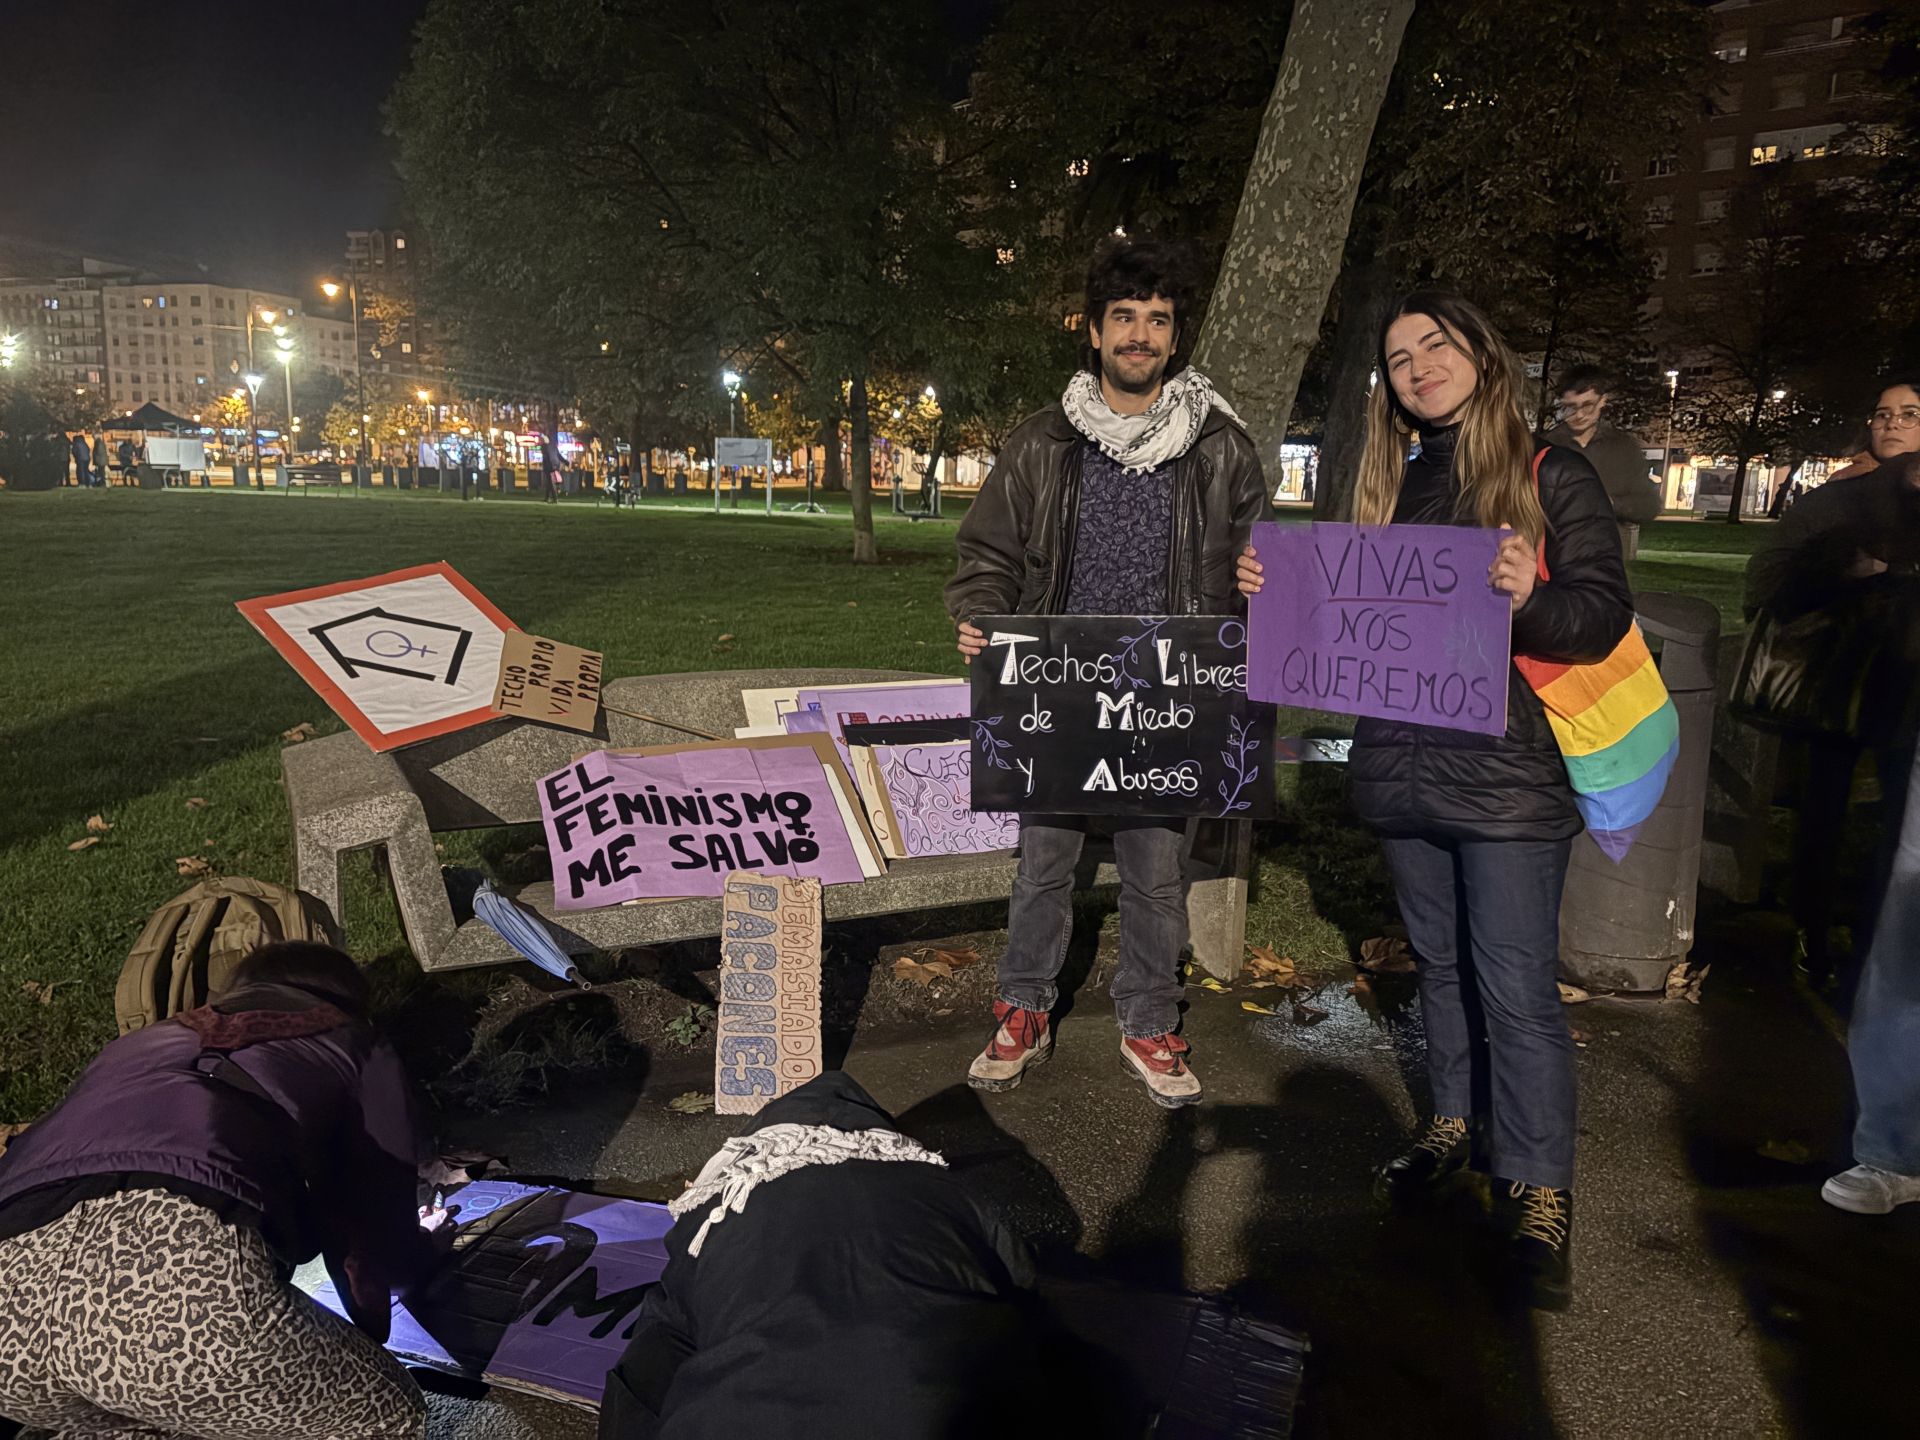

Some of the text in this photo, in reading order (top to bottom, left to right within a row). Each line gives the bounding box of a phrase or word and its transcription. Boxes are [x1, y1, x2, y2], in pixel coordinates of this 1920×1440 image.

[1333, 607, 1412, 652] NOS
[528, 641, 556, 688] PROPIO
[577, 654, 602, 702] PROPIA
[989, 631, 1247, 688] Techos Libres
[499, 665, 527, 710] TECHO
[547, 679, 575, 715] VIDA
[1281, 647, 1494, 722] QUEREMOS
[1019, 691, 1195, 732] de Miedo
[544, 762, 615, 811] EL
[1016, 757, 1198, 793] y Abusos
[568, 829, 820, 899] ME SALVÓ
[719, 881, 779, 1097] PACONES
